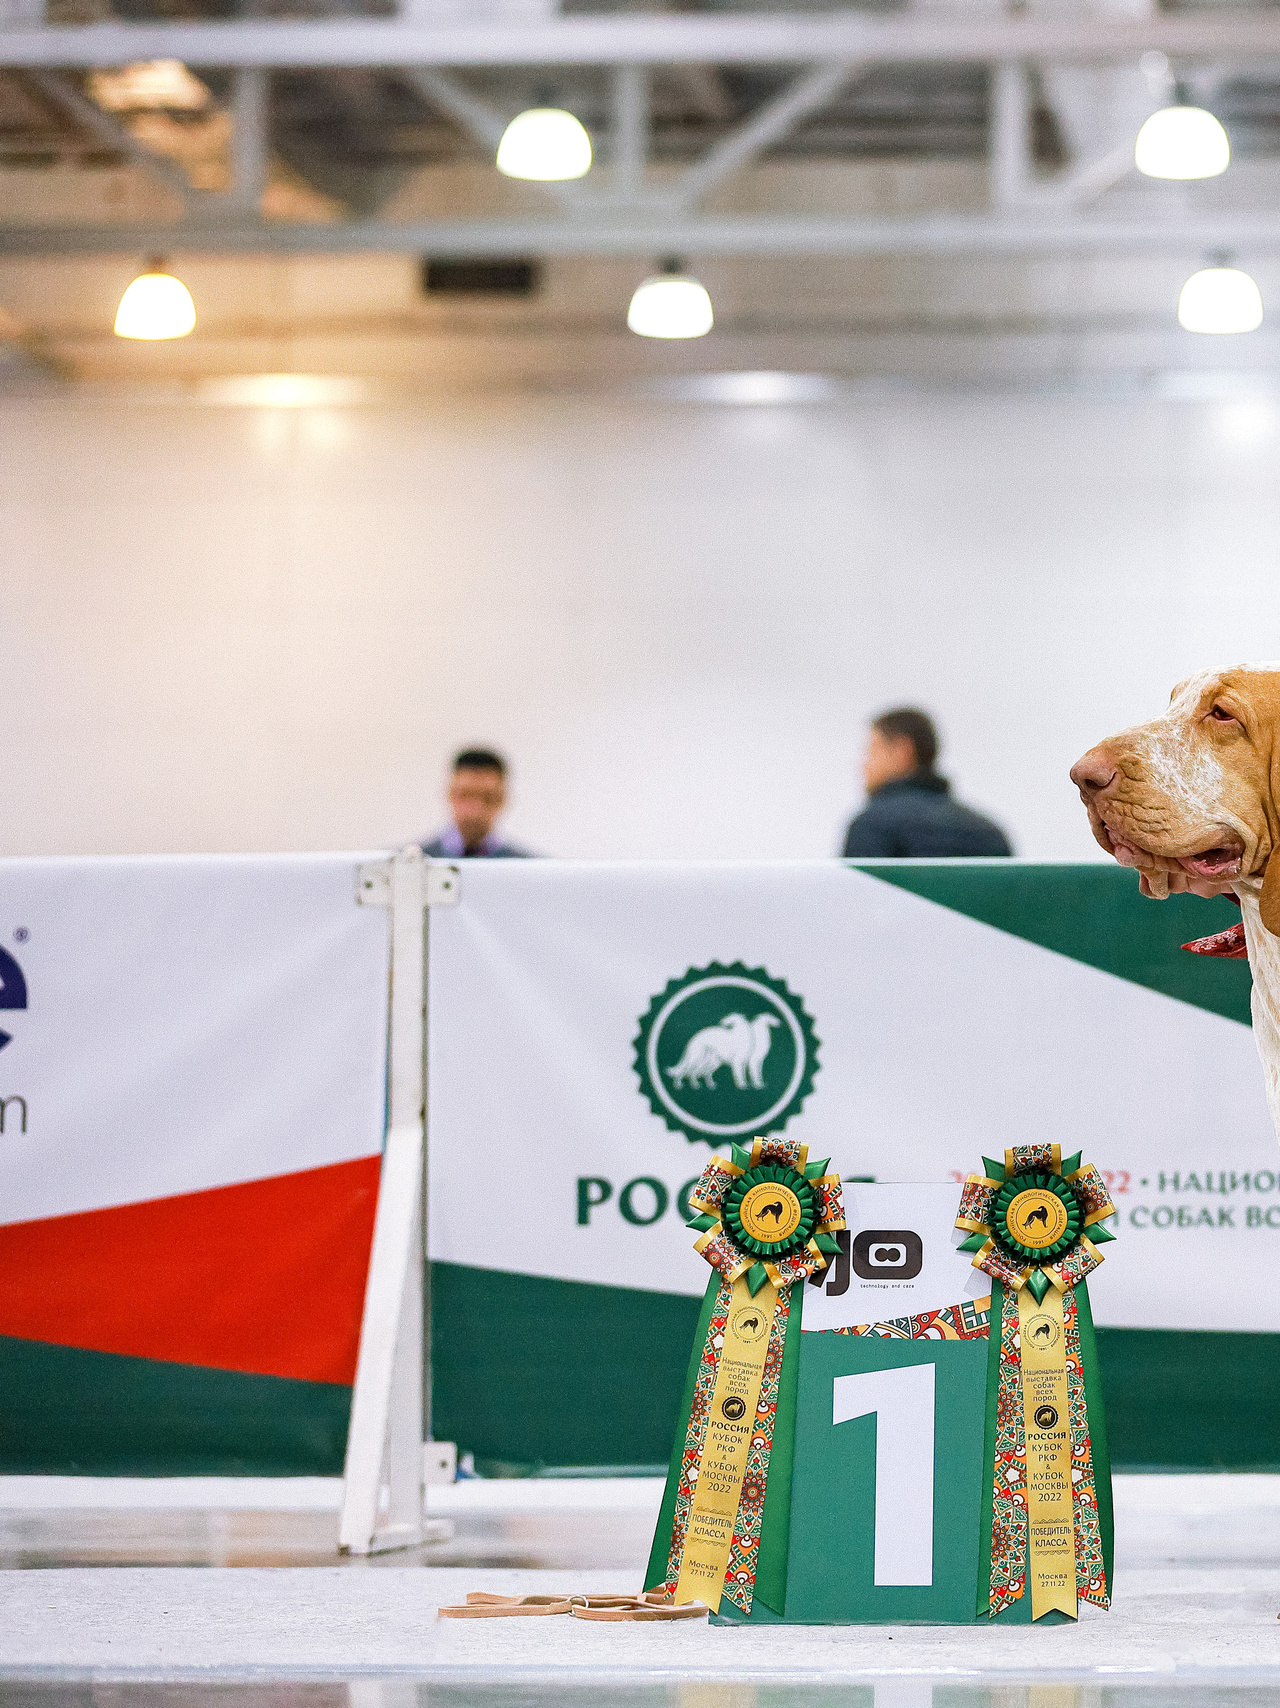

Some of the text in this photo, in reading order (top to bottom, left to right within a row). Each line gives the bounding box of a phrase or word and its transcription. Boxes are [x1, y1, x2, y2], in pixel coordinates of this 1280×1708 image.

[1129, 1205, 1236, 1229] СОБАК
[728, 1373, 750, 1382] собак
[729, 1380, 747, 1388] всех
[1033, 1381, 1056, 1389] собак
[725, 1386, 749, 1395] пород
[1033, 1395, 1057, 1403] пород
[711, 1421, 750, 1434] РОССИЯ
[713, 1433, 743, 1444] КУБОК
[1028, 1432, 1067, 1441] РОССИЯ
[717, 1443, 736, 1453] РКФ
[1031, 1443, 1063, 1452] КУБОК
[1038, 1453, 1058, 1462] РКФ
[707, 1461, 738, 1472] КУБОК
[702, 1470, 740, 1484] МОСКВЫ
[833, 1362, 936, 1587] 1
[1033, 1471, 1064, 1480] КУБОК
[707, 1482, 731, 1493] 2022
[1030, 1482, 1069, 1491] МОСКВЫ
[1038, 1492, 1062, 1502] 2022
[692, 1514, 733, 1528] ПОБЕДИТЕЛЬ
[694, 1526, 726, 1539] КЛАССА
[1031, 1526, 1072, 1536] ПОБЕДИТЕЛЬ
[1035, 1539, 1068, 1548] КЛАССА
[689, 1560, 718, 1571] Москва
